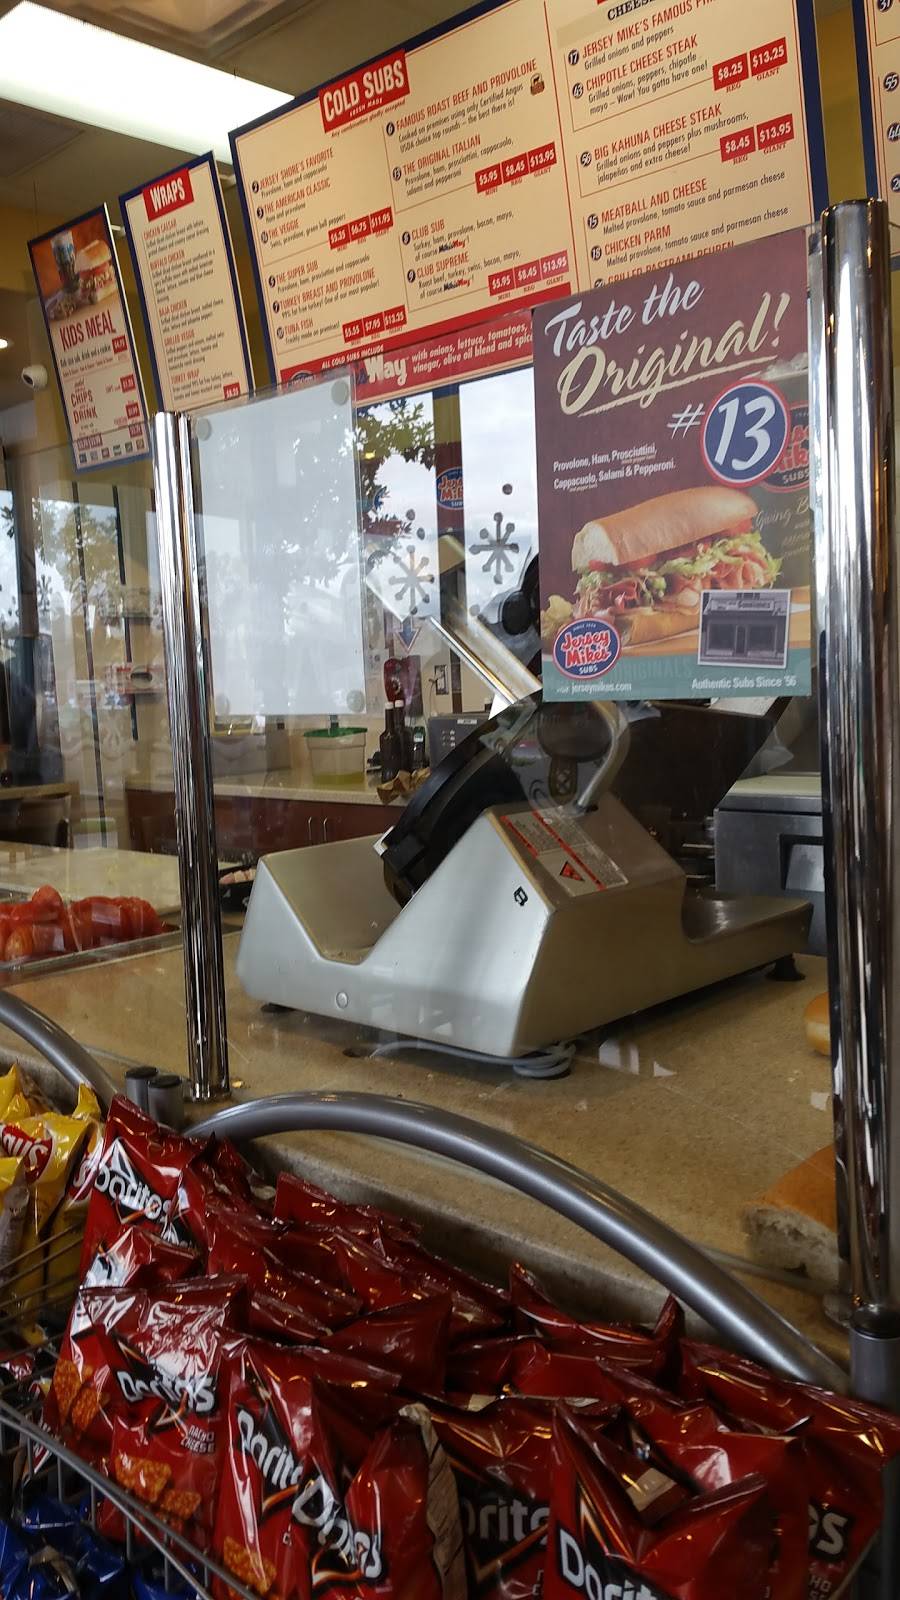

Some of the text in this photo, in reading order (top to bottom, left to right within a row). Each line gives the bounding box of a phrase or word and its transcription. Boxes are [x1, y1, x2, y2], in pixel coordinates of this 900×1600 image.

[569, 0, 693, 64] 17 JERSEY MIKE'S FAMOUS
[584, 25, 674, 70] Grilled onions and peppers
[586, 64, 628, 91] CHIPOTLE
[630, 50, 664, 75] CHEESE
[666, 34, 698, 58] STEAK
[588, 53, 697, 103] Grilled onions, peppers, chipotle
[718, 45, 785, 81] $8.25 $13.25
[756, 68, 780, 81] GIANT
[323, 60, 404, 122] COLD SUBS
[396, 58, 537, 131] FAMOUS ROAST BEEF AND PROVOLONE
[590, 60, 708, 115] mayo Wow! You gotta have one!
[884, 74, 899, 89] 55
[451, 82, 524, 120] using only Angus
[468, 101, 506, 125] the there
[594, 143, 609, 161] BIG
[611, 130, 650, 155] KAHUNA
[653, 115, 687, 139] CHEESE
[690, 103, 722, 126] STEAK
[597, 111, 749, 172] Grilled onions and peppers plus mushrooms,
[726, 122, 791, 154] $8.45 $13.95
[260, 147, 334, 190] JERSEY SHORE'S FAVORITE
[403, 134, 481, 174] THE ORIGINAL ITALIAN
[479, 149, 554, 186] $5.95 $8.45 $13.95
[630, 143, 691, 171] and extra cheese!
[150, 177, 185, 213] WRAPS
[276, 177, 331, 210] AMERICAN CLASSIC
[588, 178, 707, 228] 15 MEATBALL AND CHEESE
[604, 171, 785, 235] Melted provolone, tomato sauce and parmesan cheese
[279, 218, 299, 235] VEGGIE
[411, 219, 445, 241] CLUB SUB
[605, 225, 671, 256] CHICKEN PARM
[607, 206, 788, 268] Melted provolone, tomato sauce and parmesan cheese
[307, 260, 318, 273] SUB
[416, 251, 469, 278] CLUB SUPREME
[492, 257, 567, 290] $5.95 $8.45 $13.95
[302, 267, 375, 300] BREAST AND PROVOLONE
[60, 322, 84, 352] KIDS
[85, 309, 116, 340] MEAL
[284, 318, 313, 336] TUNA FISH
[545, 272, 704, 357] Taste the
[411, 322, 527, 363] with onions, lettuce, tomatoes,
[412, 360, 442, 373] vinegar,
[443, 354, 461, 368] olive
[463, 348, 473, 361] oil
[475, 344, 495, 359] blend
[498, 339, 512, 350] and
[557, 291, 791, 415] Original!
[363, 354, 408, 386] Way
[71, 390, 93, 408] CHIPS
[73, 405, 98, 424] DRINK
[714, 395, 776, 471] 13
[553, 458, 591, 472] Provolone,
[591, 453, 610, 465] Ham,
[598, 467, 625, 482] Salami
[634, 458, 676, 476] Pepperoni.
[561, 630, 611, 652] Jersey
[579, 665, 598, 675] SUBS
[692, 678, 731, 689] Authentic
[733, 676, 755, 688] Subs
[756, 676, 782, 688] Since
[181, 1438, 215, 1452] CHEESE
[188, 1424, 215, 1441] NACHO
